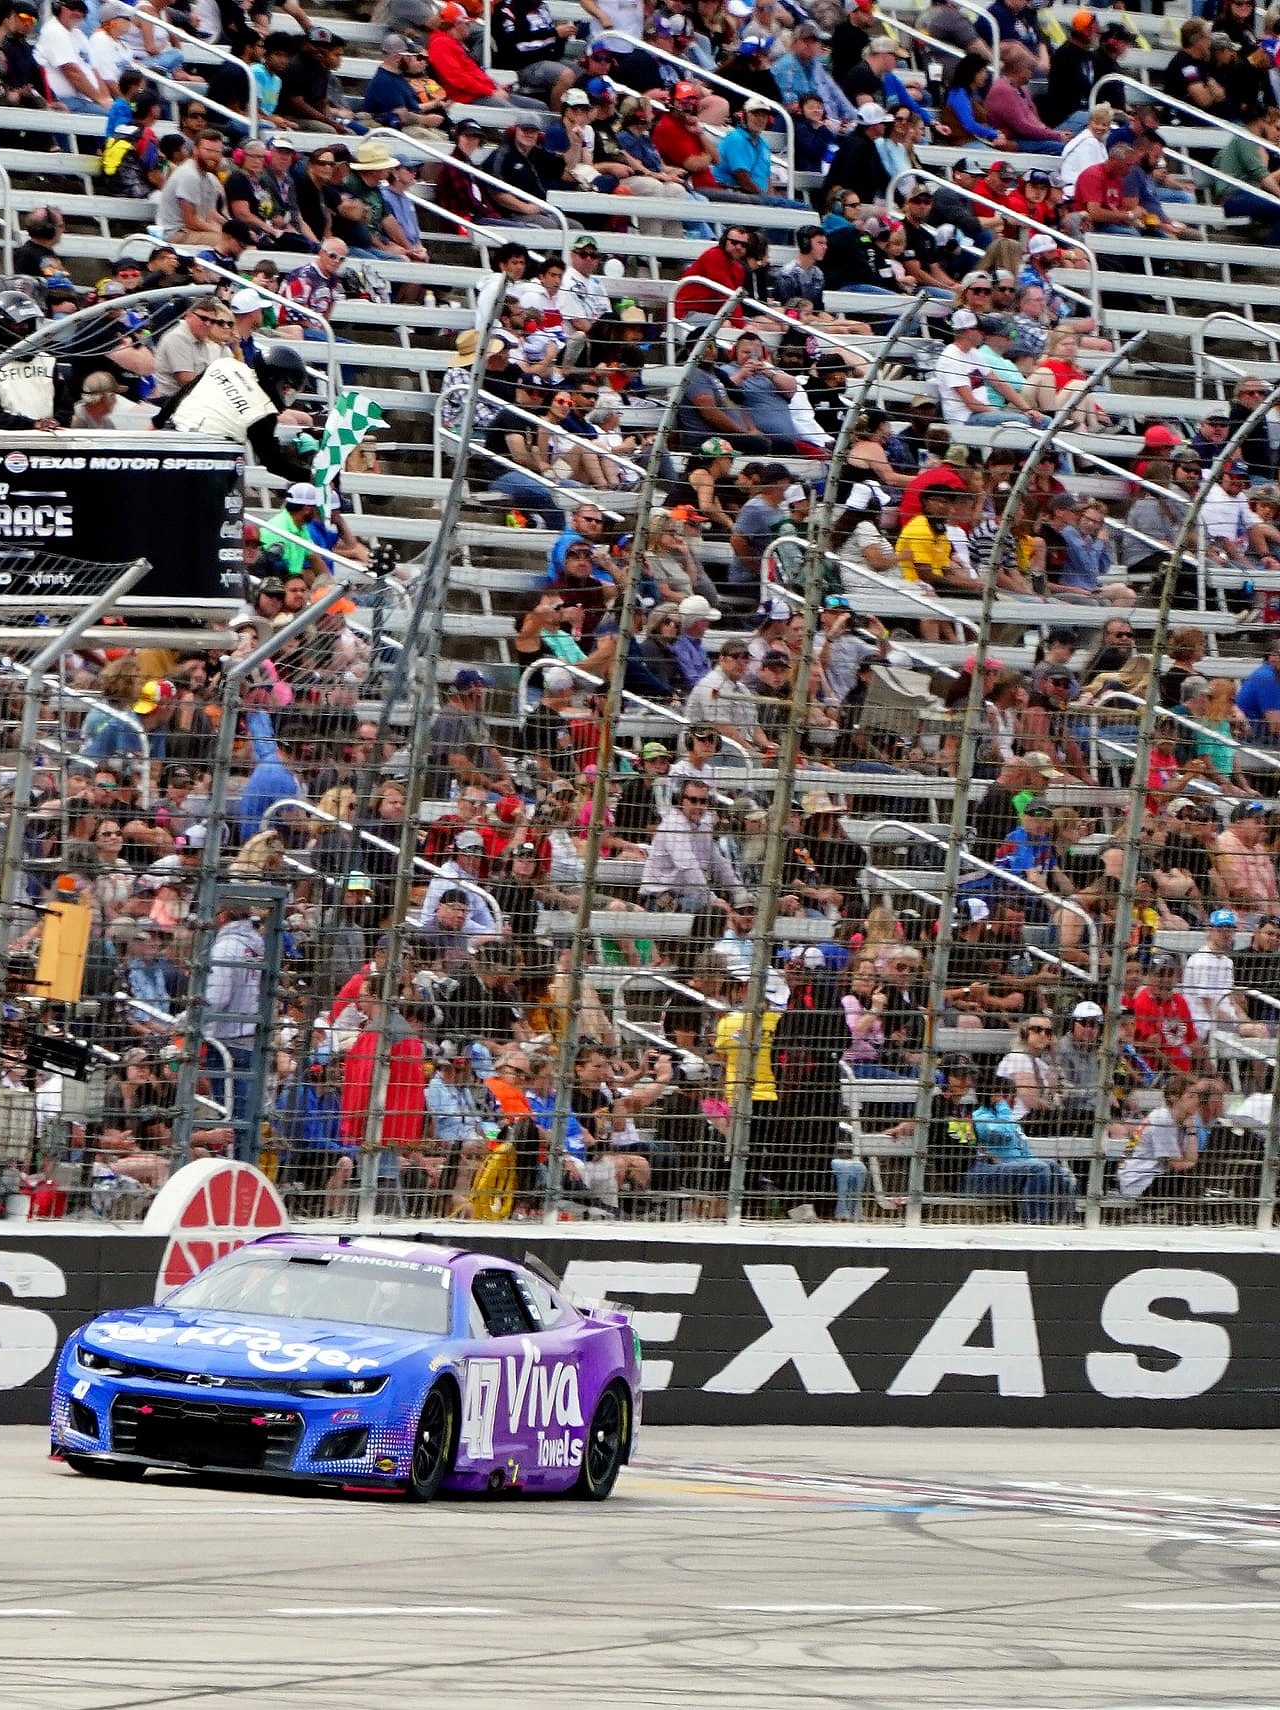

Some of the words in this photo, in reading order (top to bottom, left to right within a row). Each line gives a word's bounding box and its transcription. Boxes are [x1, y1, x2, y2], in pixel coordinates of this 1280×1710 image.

[209, 367, 252, 416] OFFICIAL
[29, 456, 87, 469] TEXAS
[89, 457, 160, 470] MOTOR
[320, 1251, 421, 1271] STENHOUSE
[176, 1325, 380, 1373] Kroger
[558, 1259, 1240, 1399] EXAS
[460, 1356, 502, 1460] 47
[506, 1337, 585, 1434] Viva
[537, 1430, 585, 1467] Towels
